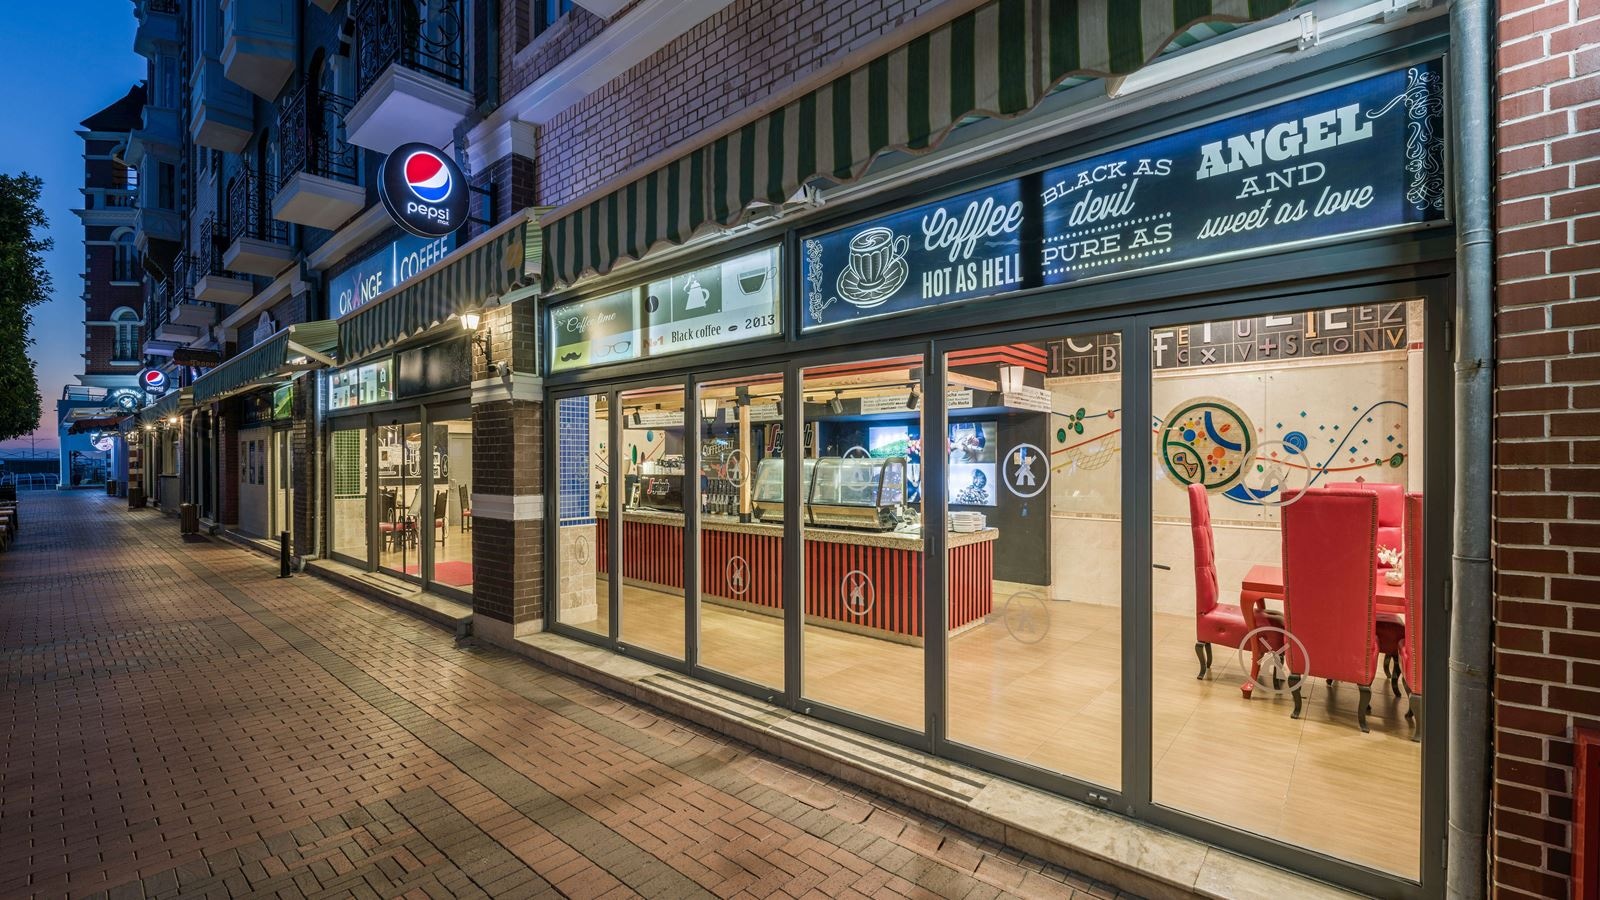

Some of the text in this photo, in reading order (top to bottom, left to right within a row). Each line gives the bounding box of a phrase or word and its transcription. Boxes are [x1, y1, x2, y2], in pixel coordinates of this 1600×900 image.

[1195, 103, 1373, 180] ANGEL
[1040, 158, 1172, 207] BLACK AS
[1068, 178, 1137, 227] devil
[1236, 161, 1326, 199] AND
[407, 202, 449, 220] pepsi
[922, 200, 1024, 263] Coffee
[1197, 184, 1374, 240] sweet as love
[1041, 223, 1172, 266] PURE AS
[922, 251, 1024, 299] HOT AS HELL
[566, 311, 617, 334] Coffee time
[671, 327, 694, 344] Black
[695, 324, 721, 340] coffee
[745, 314, 775, 330] 2013
